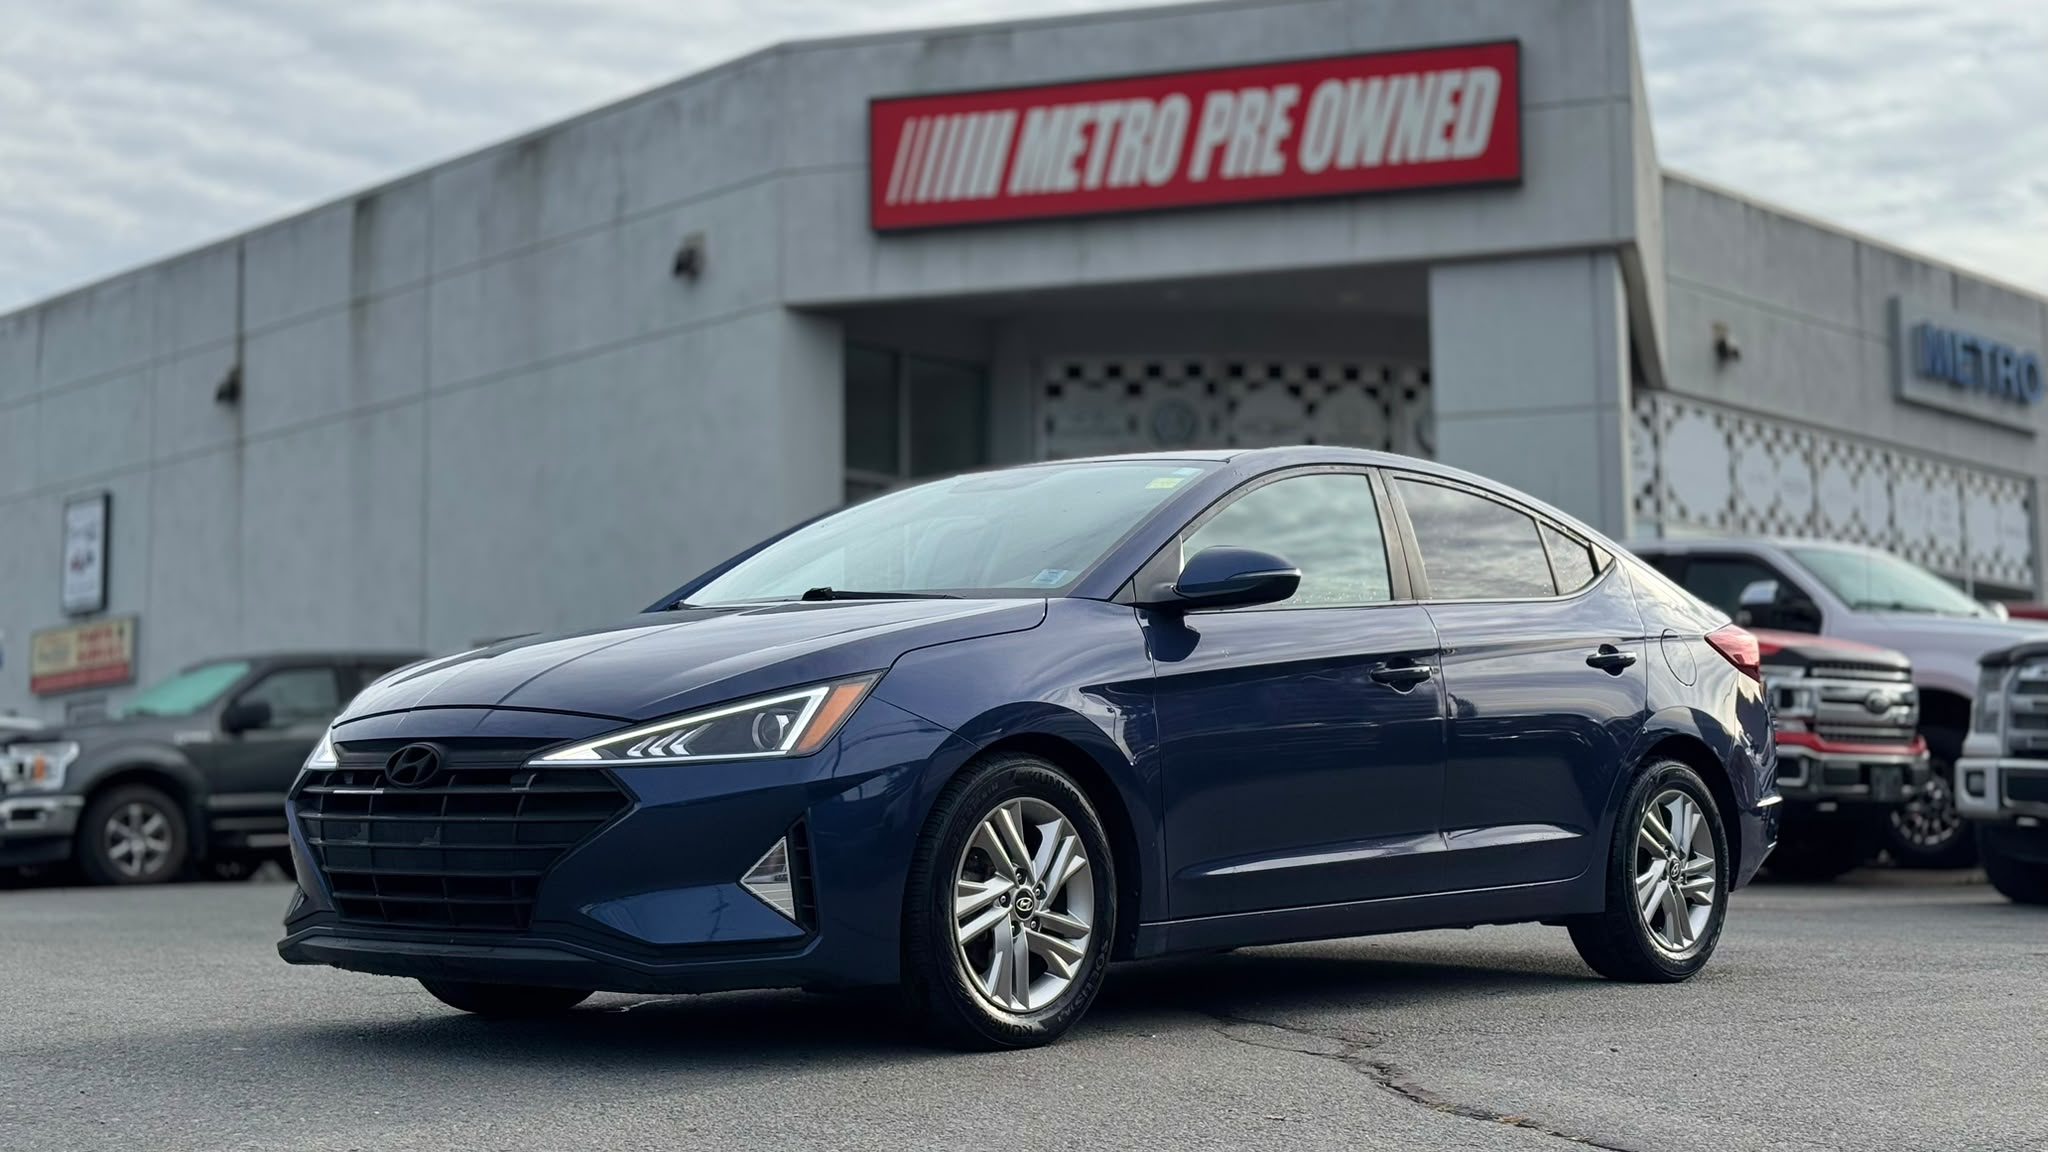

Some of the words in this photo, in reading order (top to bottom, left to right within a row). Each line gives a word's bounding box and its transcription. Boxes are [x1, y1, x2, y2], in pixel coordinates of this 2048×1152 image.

[1008, 94, 1192, 195] METRO
[1188, 85, 1301, 181] PRE
[1297, 67, 1500, 174] OWNED
[1914, 321, 2043, 404] METRO
